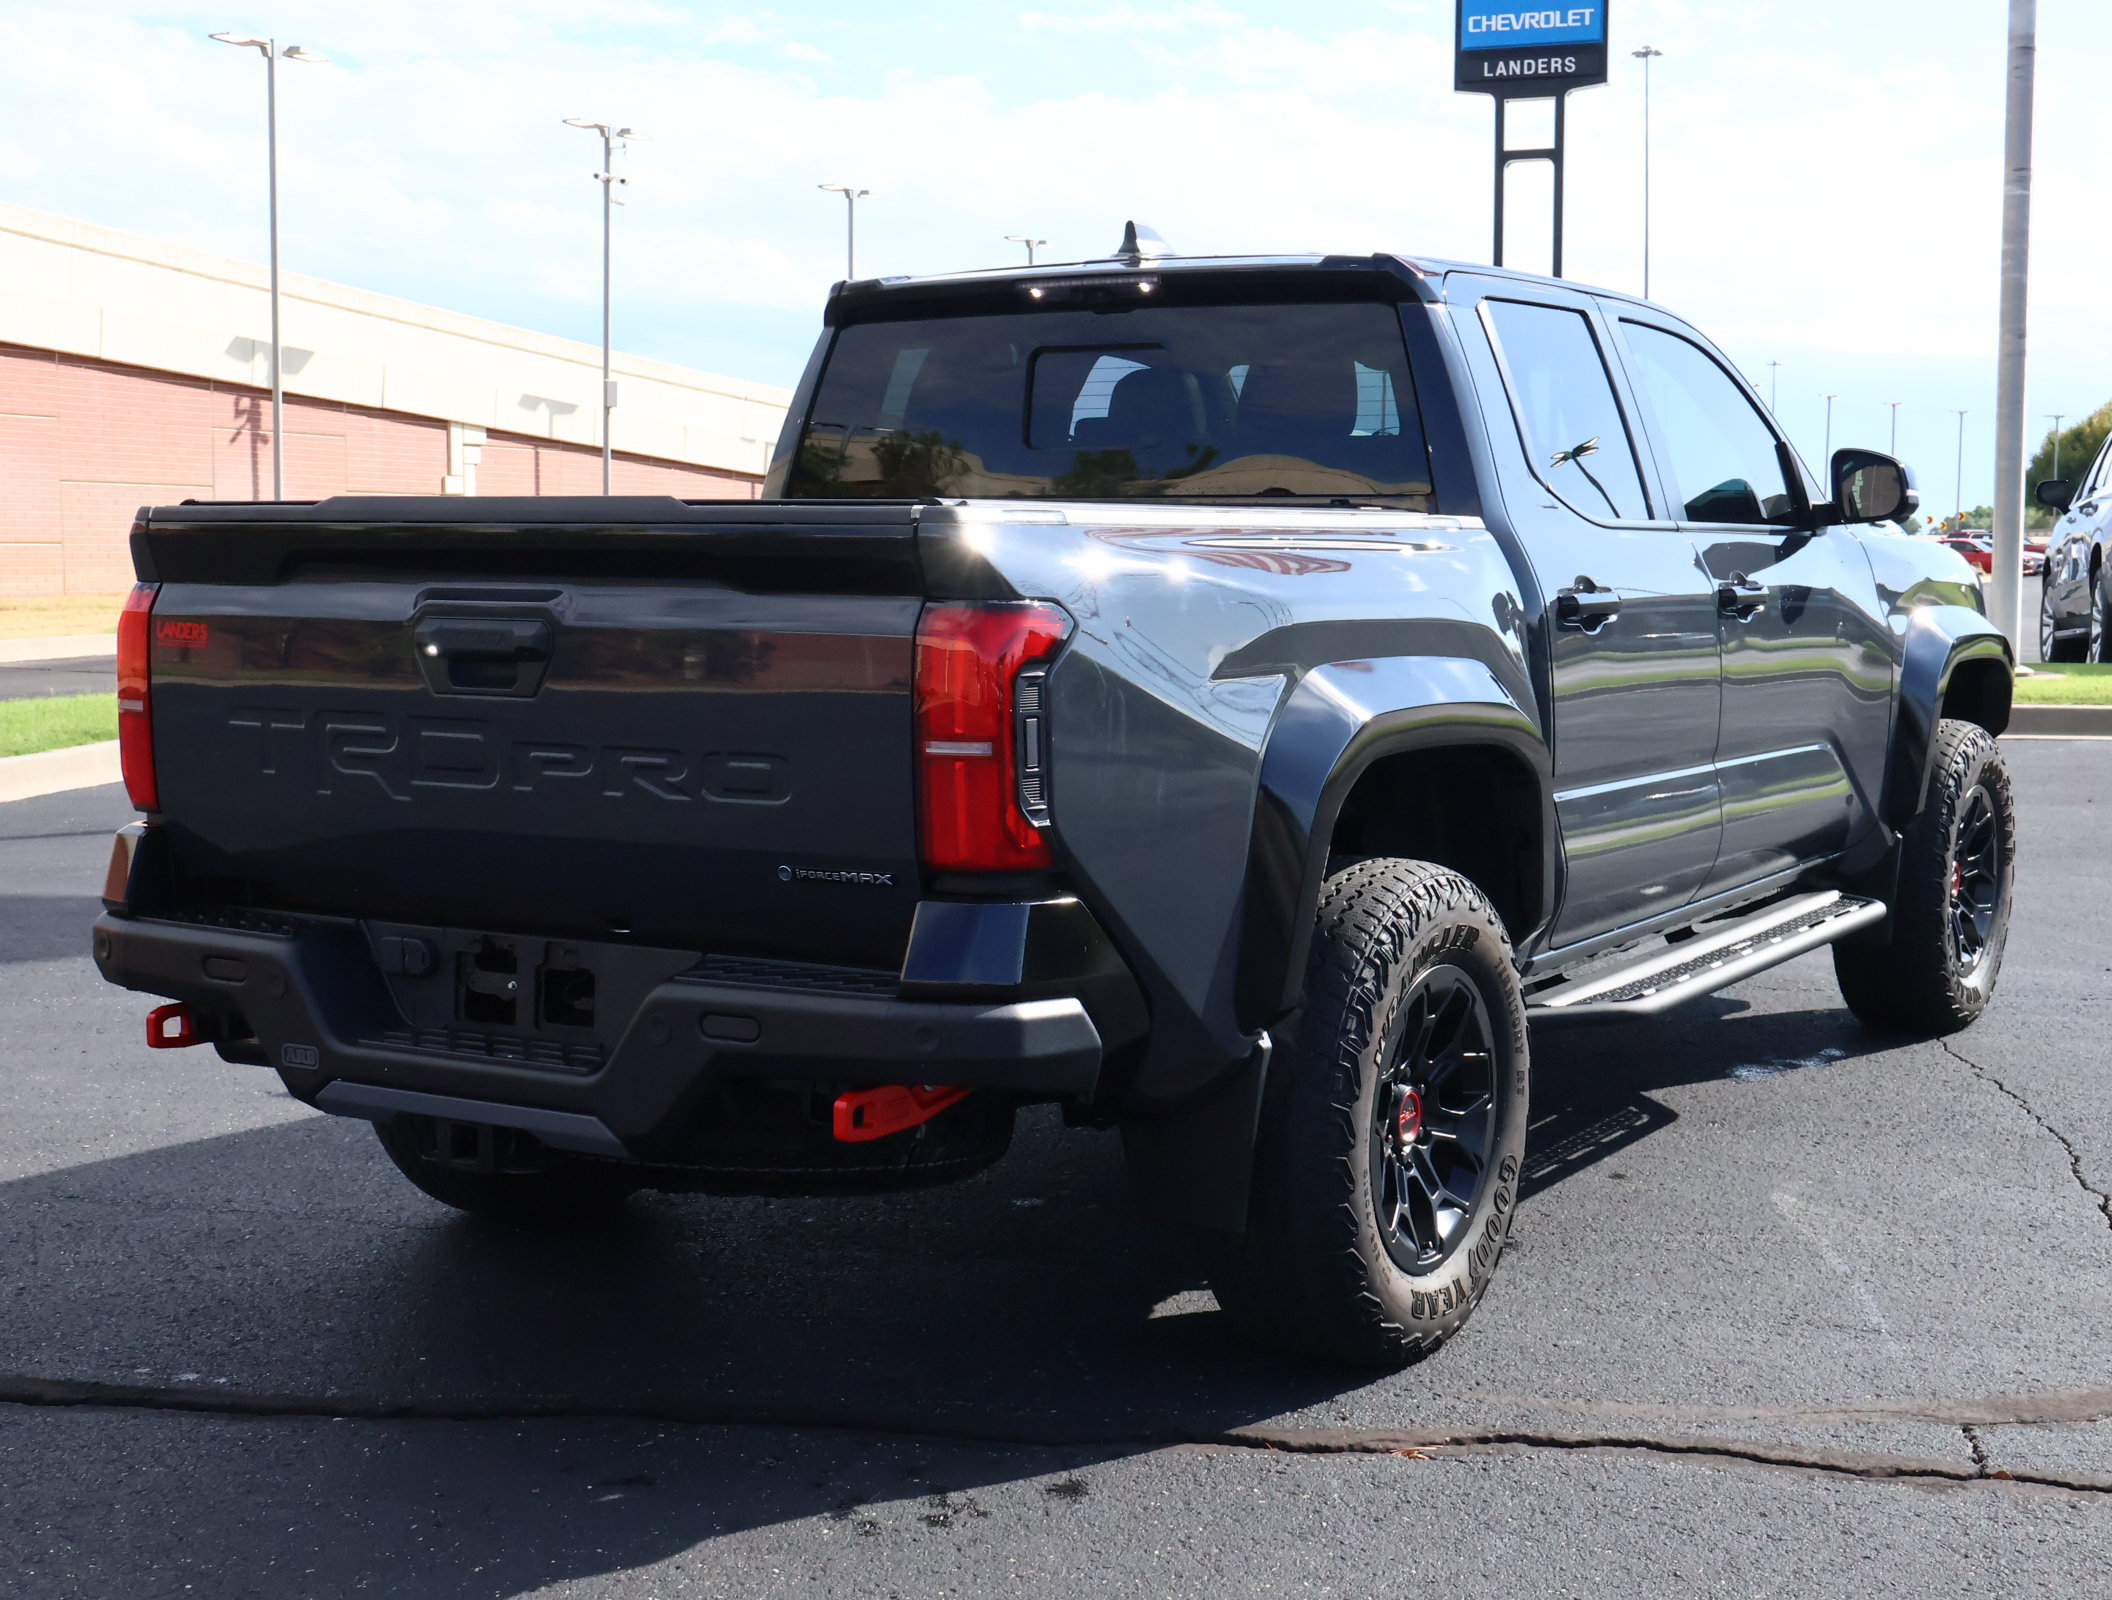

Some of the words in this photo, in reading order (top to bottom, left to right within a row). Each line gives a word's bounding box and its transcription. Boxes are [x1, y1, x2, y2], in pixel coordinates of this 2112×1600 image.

[1468, 8, 1595, 33] CHEVROLET
[1483, 57, 1576, 77] LANDERS
[226, 705, 500, 800] TRD
[510, 740, 793, 805] PRO
